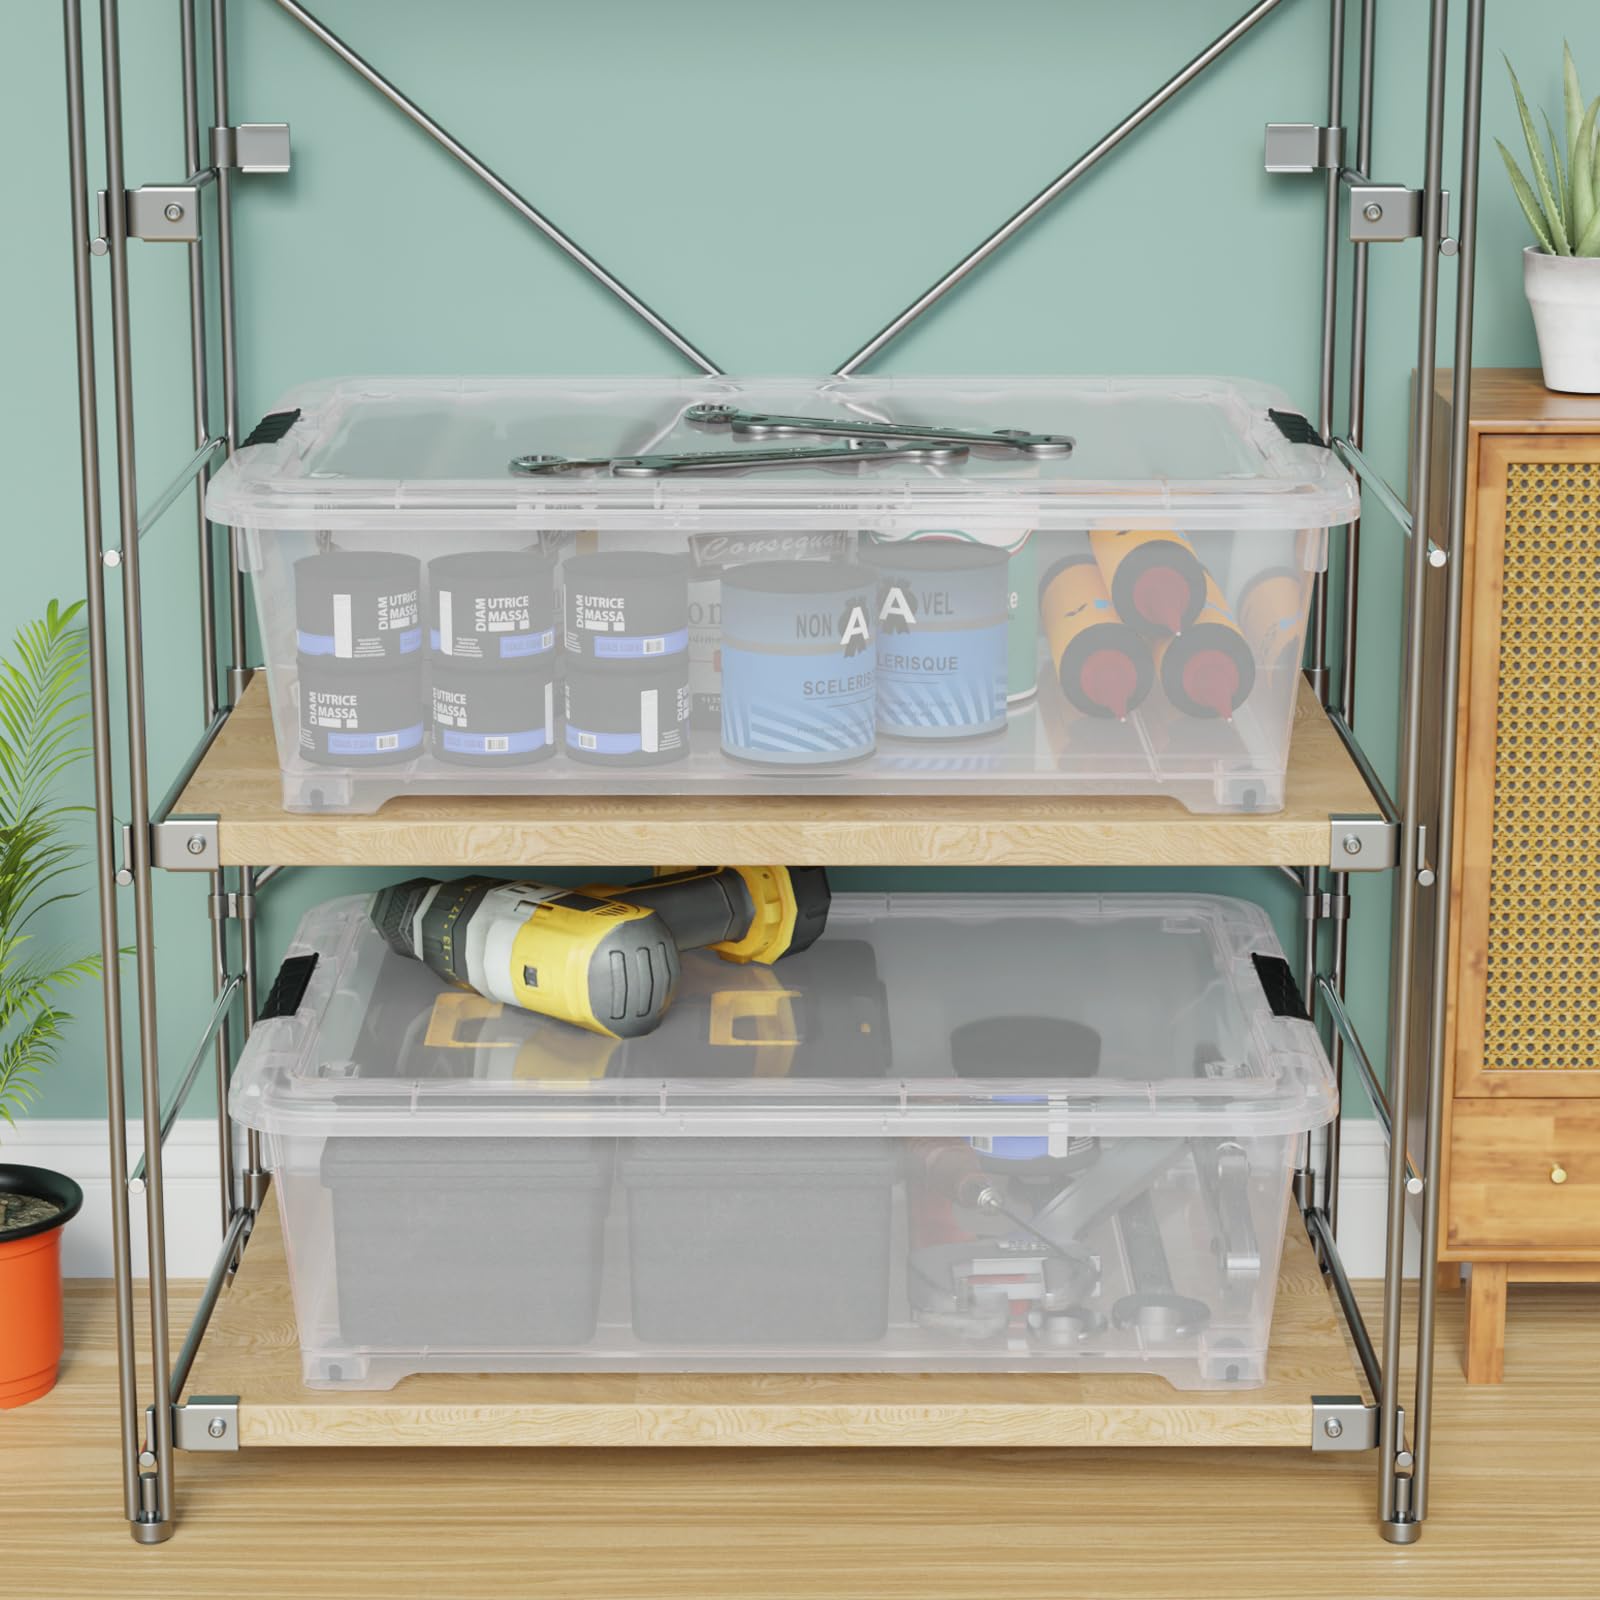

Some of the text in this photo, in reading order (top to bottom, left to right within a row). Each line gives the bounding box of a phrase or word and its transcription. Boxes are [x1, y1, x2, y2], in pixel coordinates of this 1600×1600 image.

[389, 590, 417, 606] UTRICE
[487, 595, 529, 609] UTRICE
[584, 595, 625, 609] UTRICE
[921, 591, 954, 616] VEL
[378, 596, 388, 631] DIAM
[389, 603, 418, 620] MASSA
[475, 597, 486, 632] DIAM
[487, 609, 529, 622] MASSA
[575, 594, 583, 628] DIAM
[584, 609, 625, 622] MASSA
[796, 613, 832, 639] NON
[309, 691, 317, 725] DIAM
[317, 693, 357, 706] UTRICE
[318, 706, 358, 719] MASSA
[437, 701, 467, 718] MASSA
